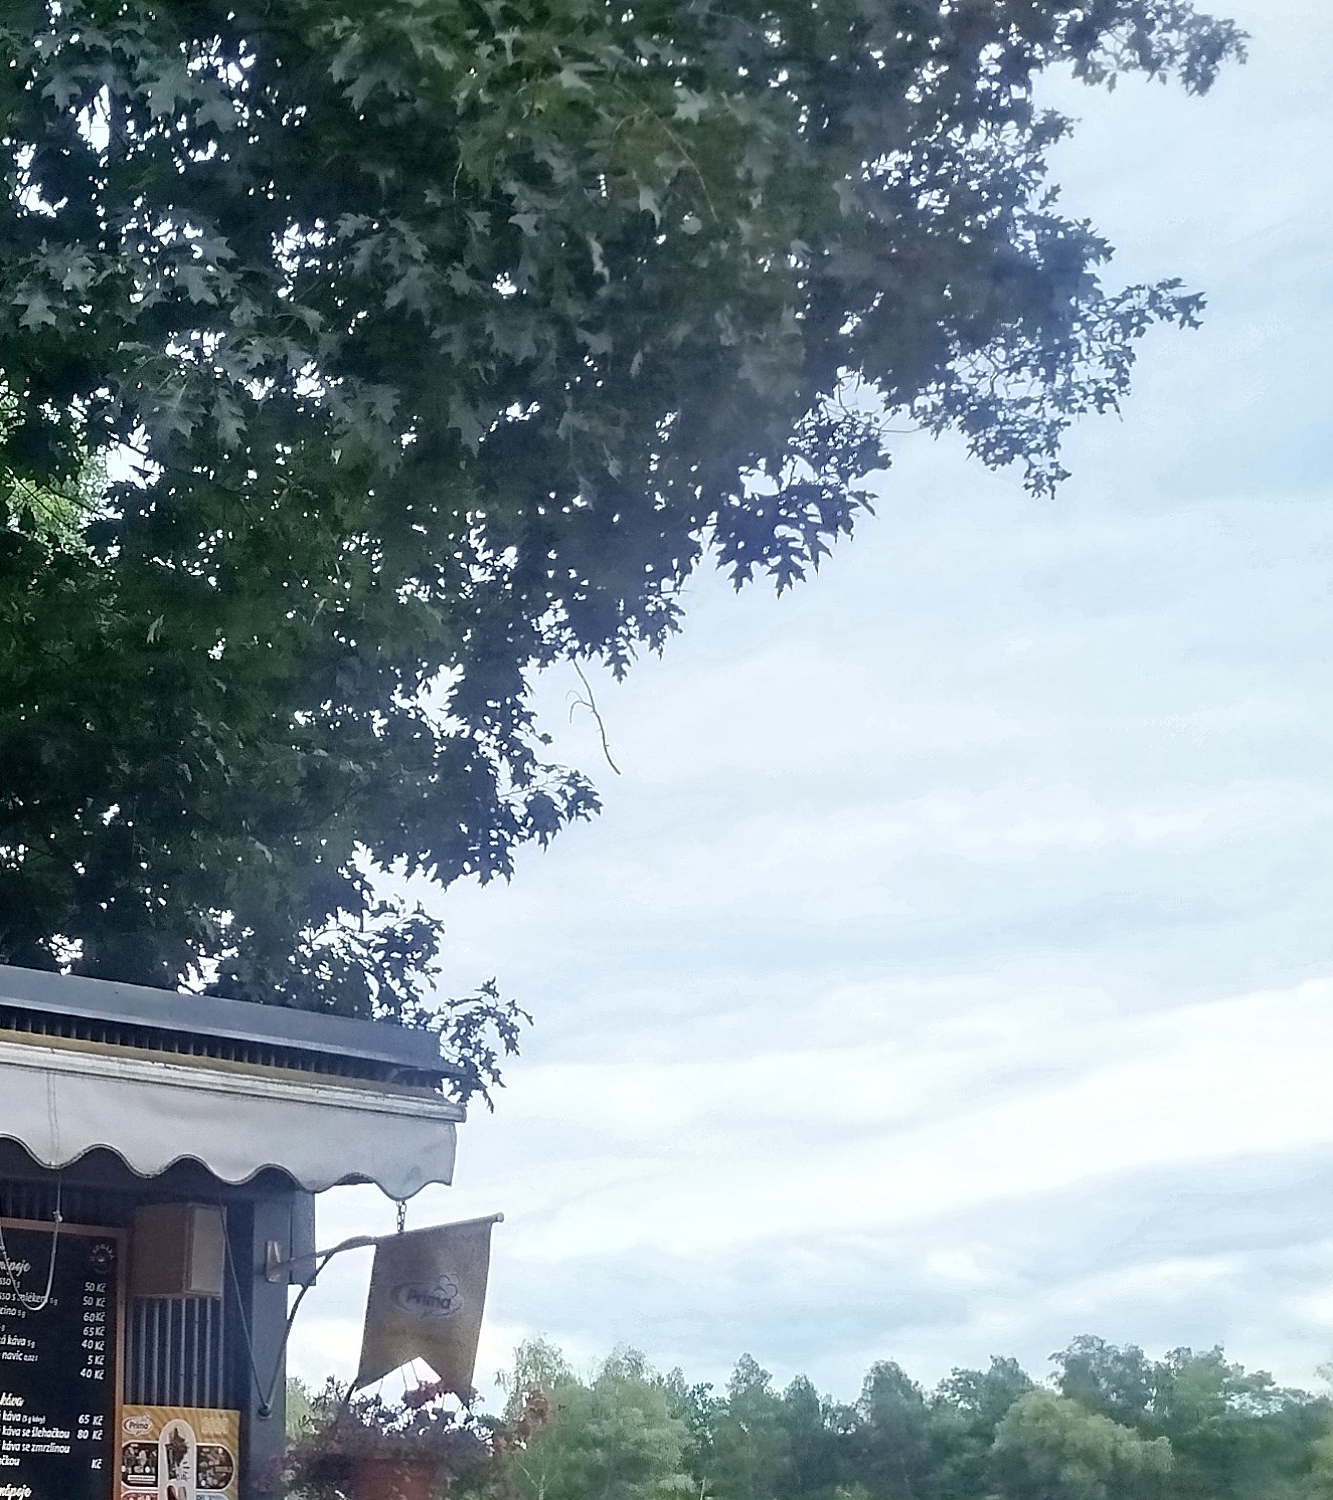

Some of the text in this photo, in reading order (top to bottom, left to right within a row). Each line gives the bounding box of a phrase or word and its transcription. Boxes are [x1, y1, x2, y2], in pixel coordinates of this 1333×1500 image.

[7, 1335, 26, 1346] káva
[0, 1392, 25, 1407] káva
[2, 1425, 21, 1436] káva
[31, 1426, 70, 1439] šlehačkou
